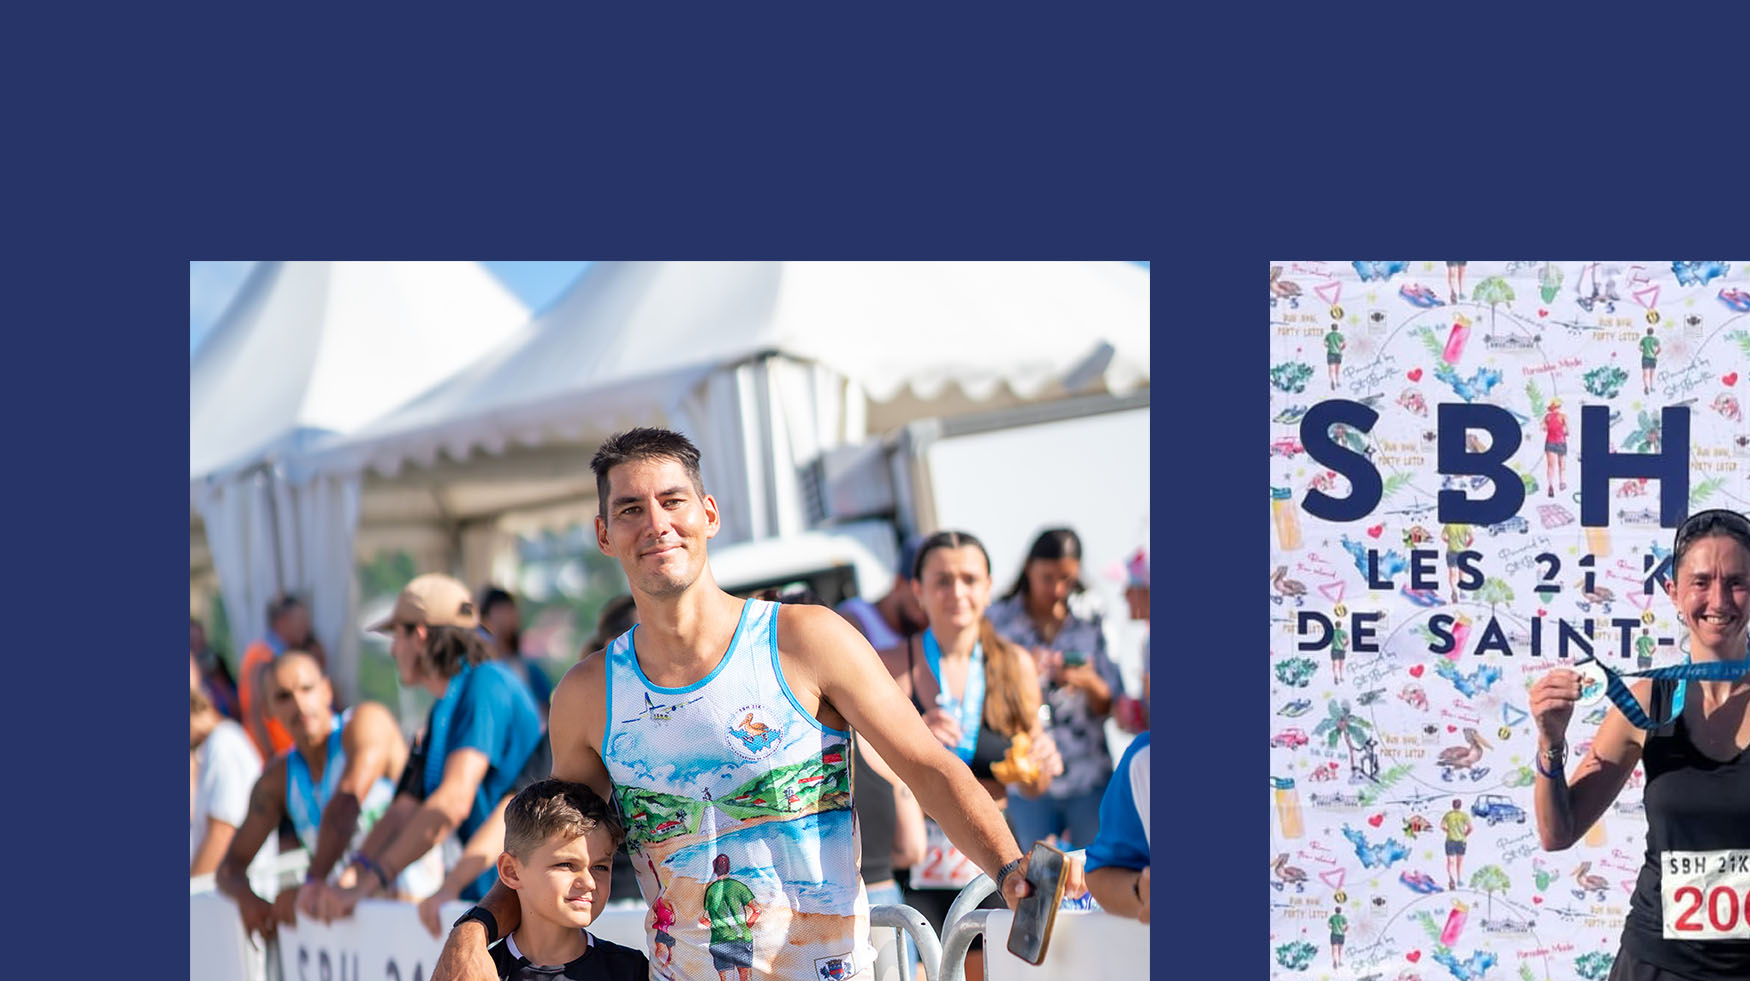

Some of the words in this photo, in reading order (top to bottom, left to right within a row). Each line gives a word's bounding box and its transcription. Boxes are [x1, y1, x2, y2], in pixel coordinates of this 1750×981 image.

[1299, 399, 1692, 529] SBH
[1369, 550, 1485, 590] LES
[1534, 553, 1595, 593] 21
[1298, 611, 1379, 653] DE
[922, 846, 982, 880] 22
[1670, 856, 1706, 874] SBH
[1718, 855, 1749, 873] 21K
